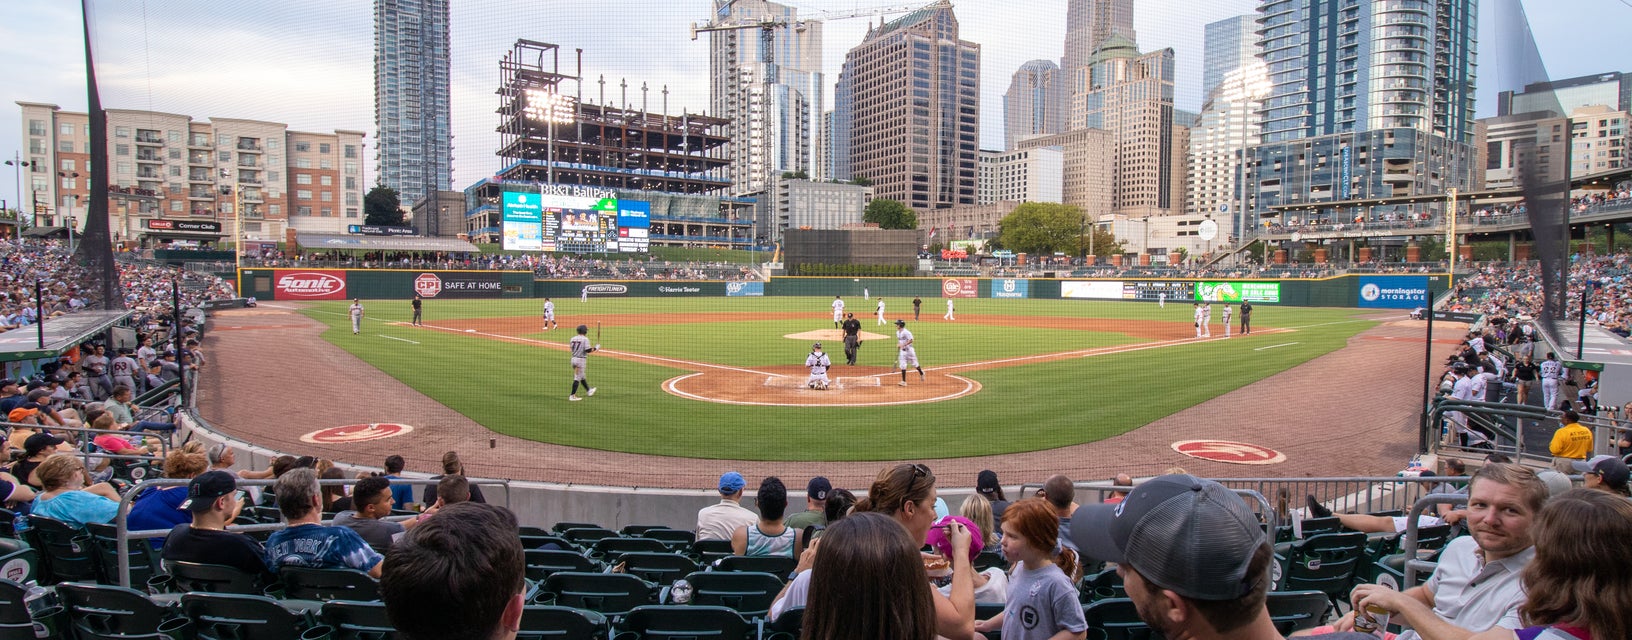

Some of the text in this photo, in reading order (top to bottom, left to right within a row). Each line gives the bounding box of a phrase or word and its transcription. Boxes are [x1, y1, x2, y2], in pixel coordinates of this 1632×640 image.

[541, 184, 617, 199] BB&T BallPark
[277, 276, 336, 289] Sonic
[417, 281, 440, 289] CPI
[478, 282, 502, 290] HOME
[1381, 287, 1426, 295] morningstar
[571, 341, 581, 351] 77
[114, 361, 127, 370] 63
[293, 538, 322, 555] YORK
